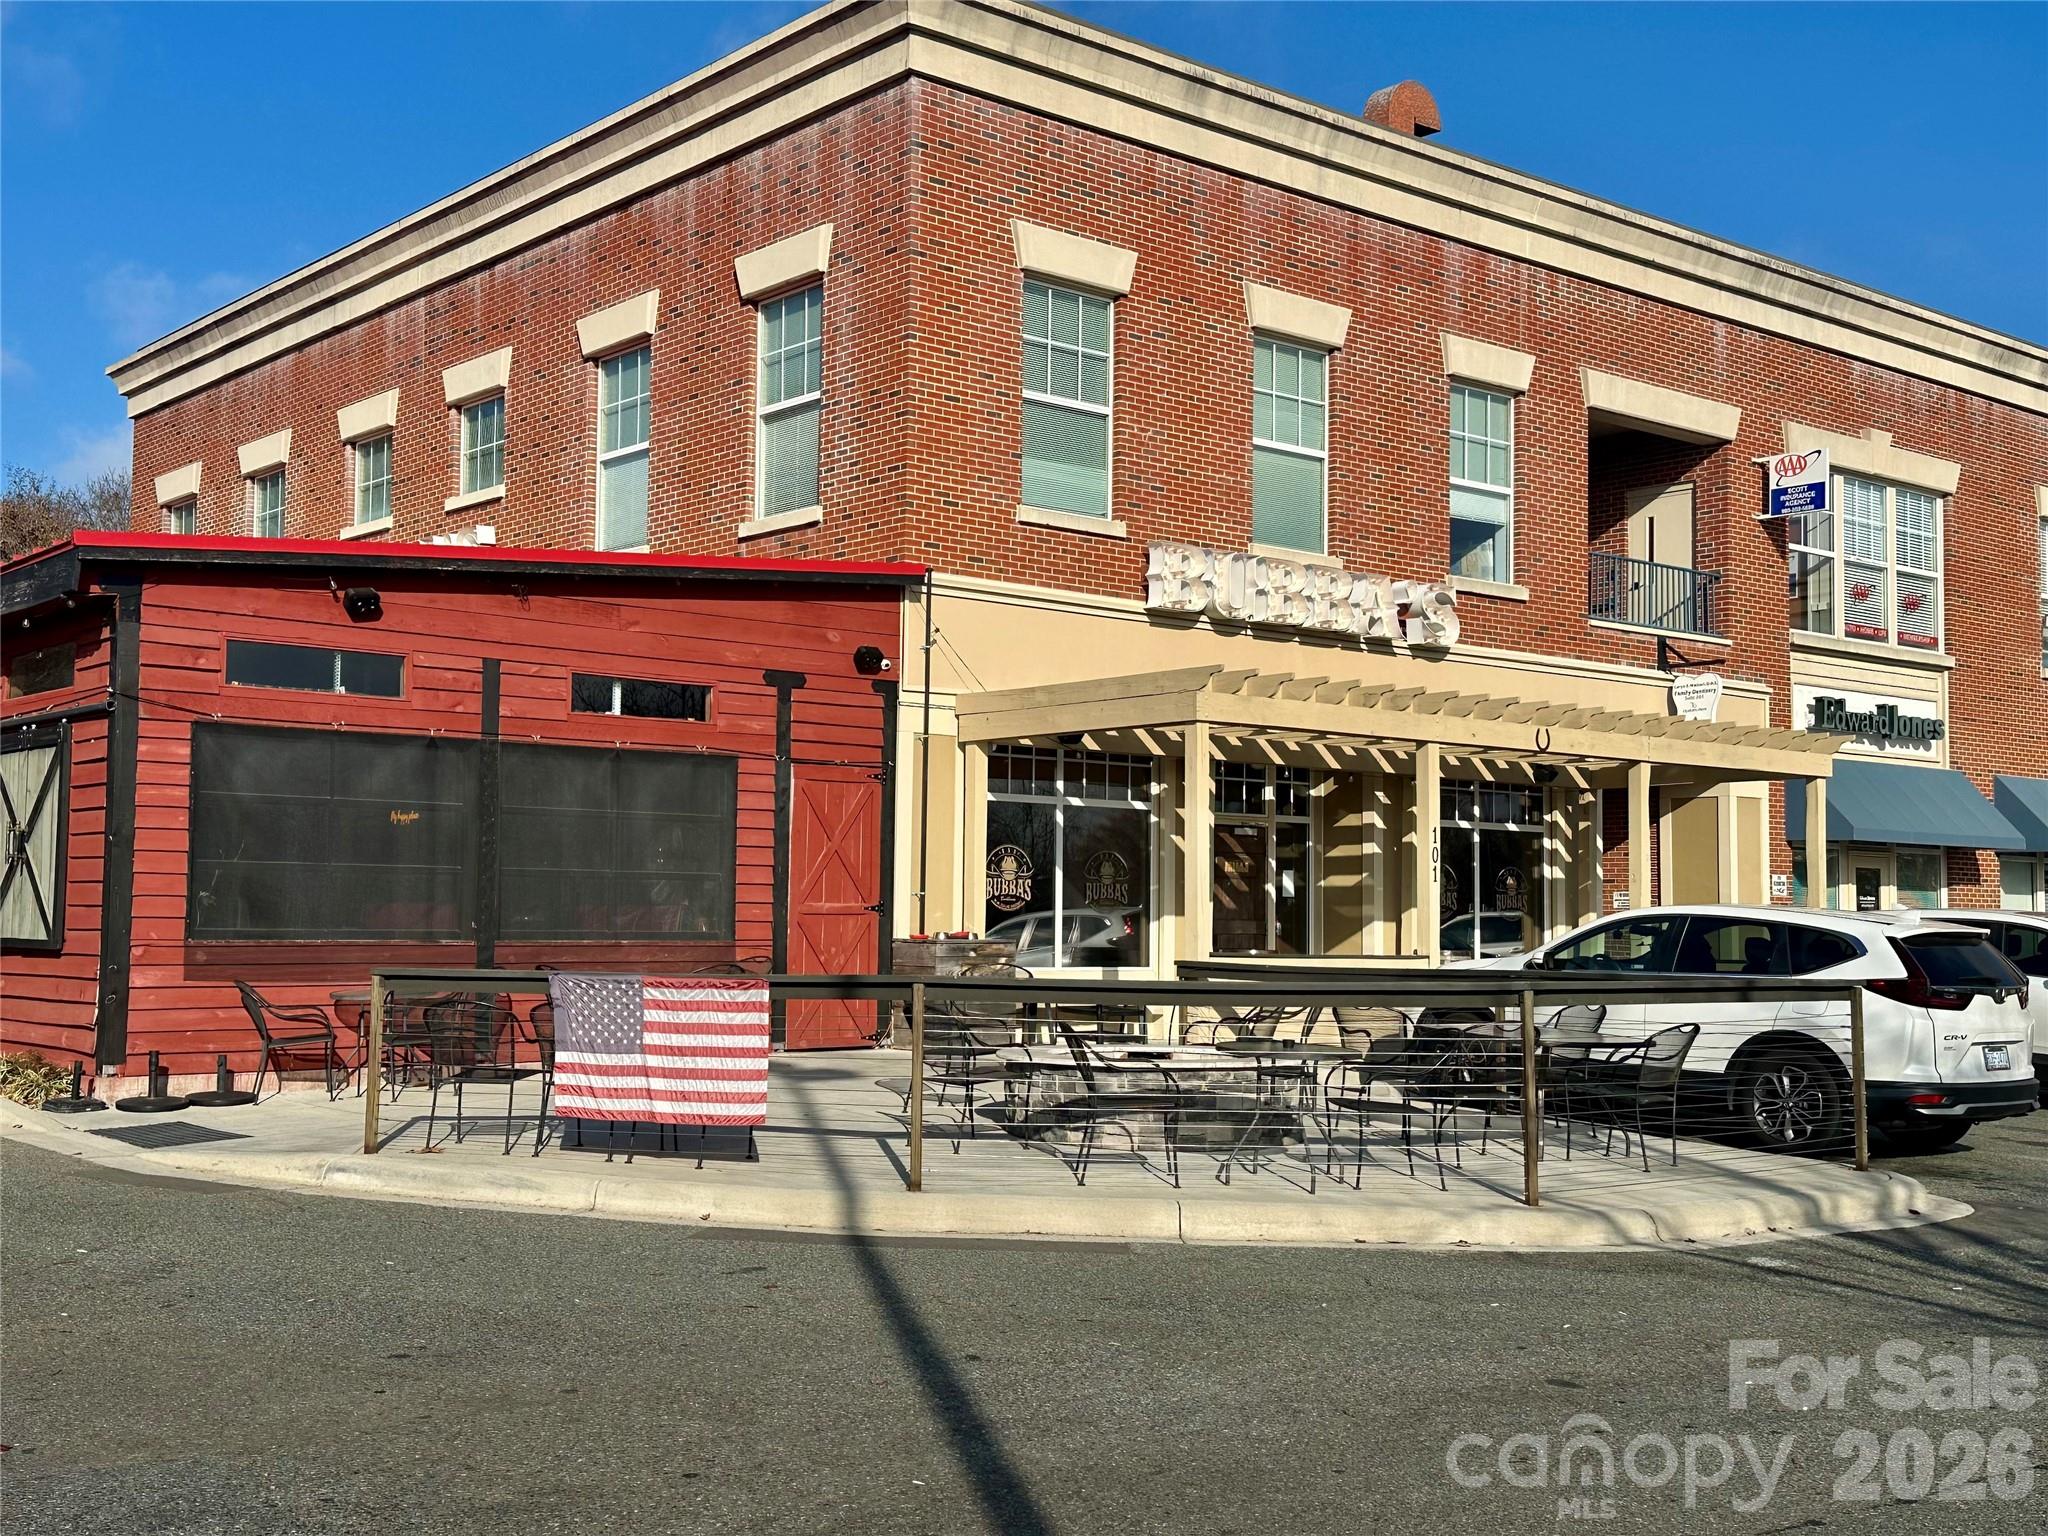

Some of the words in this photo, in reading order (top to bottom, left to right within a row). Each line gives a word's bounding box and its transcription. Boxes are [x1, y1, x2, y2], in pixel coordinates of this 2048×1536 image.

[1775, 455, 1807, 477] AAA
[1780, 491, 1816, 501] INSURANCE
[1788, 486, 1808, 494] SCOTT
[1785, 498, 1811, 507] AGENCY
[986, 877, 1032, 902] BUBBAS
[1085, 882, 1128, 905] BUBBAS
[1496, 893, 1528, 913] BUBBAS
